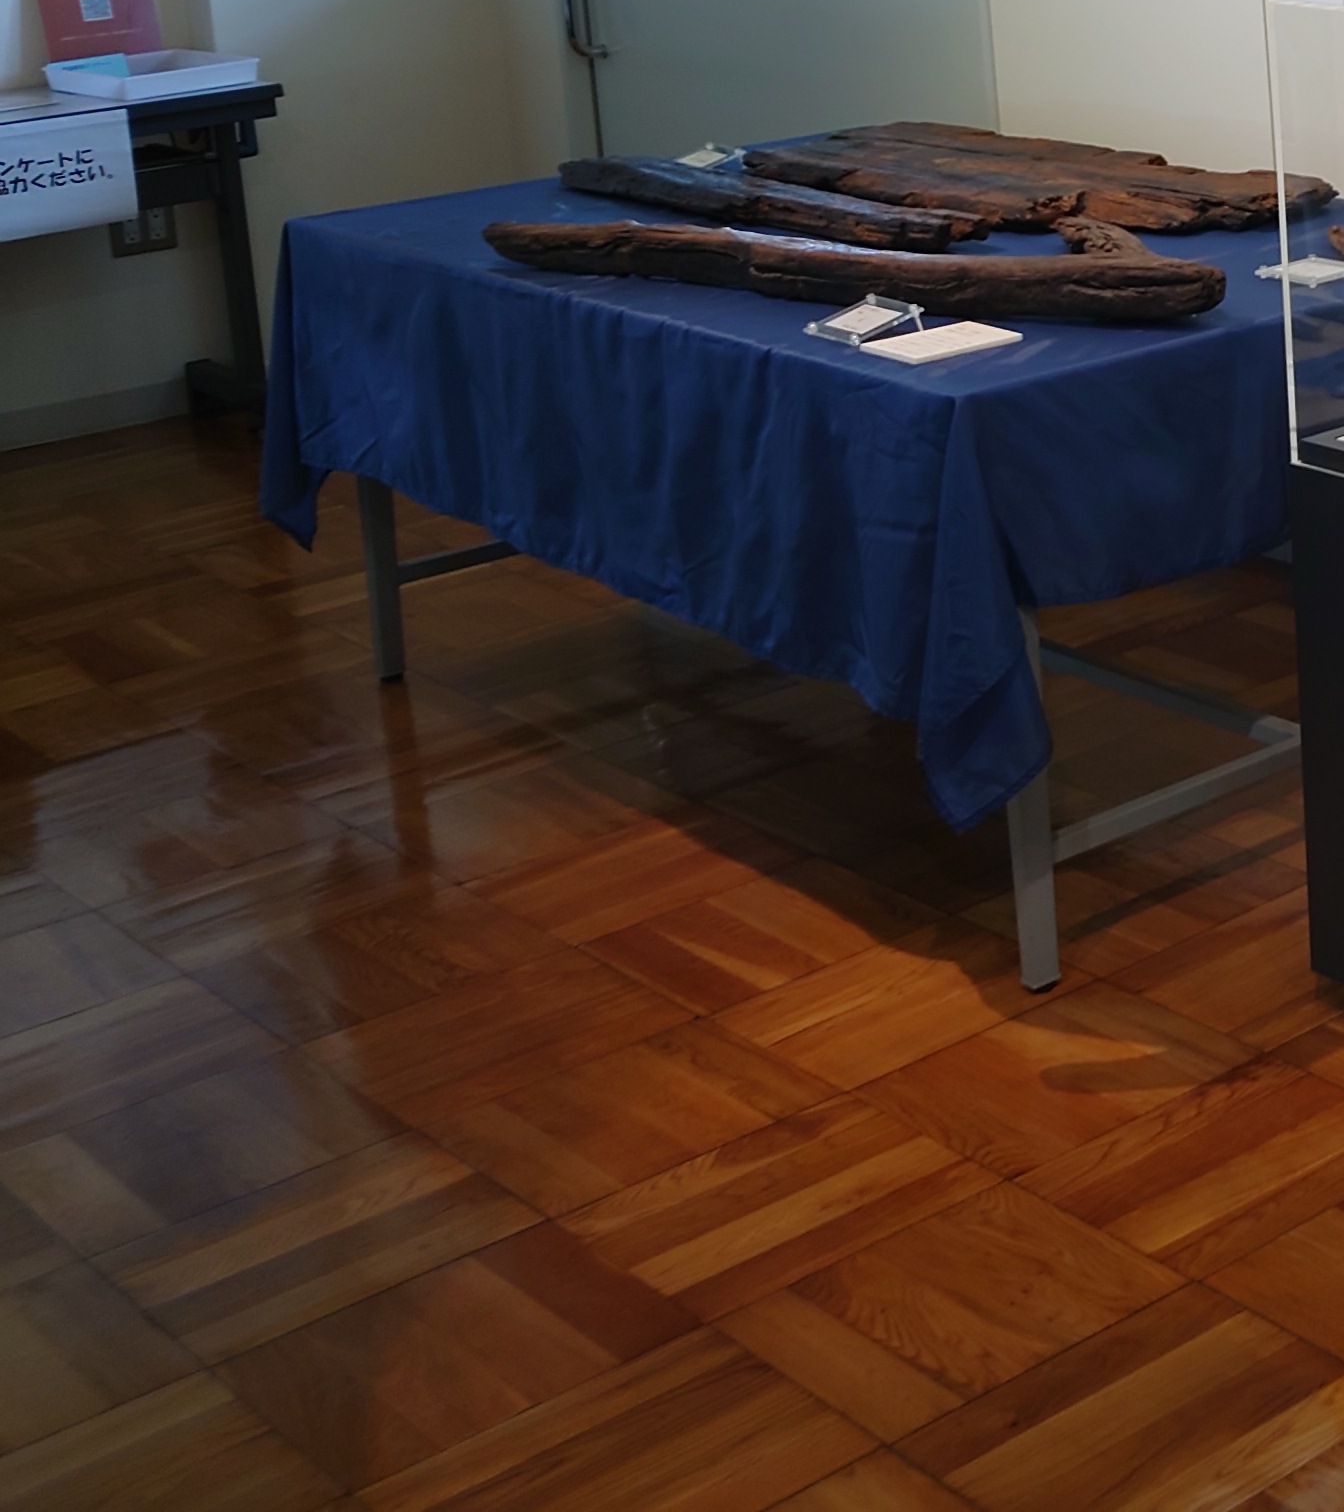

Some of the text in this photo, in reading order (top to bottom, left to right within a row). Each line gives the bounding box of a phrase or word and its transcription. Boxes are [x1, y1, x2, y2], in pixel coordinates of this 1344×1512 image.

[0, 148, 94, 176] ンケートに
